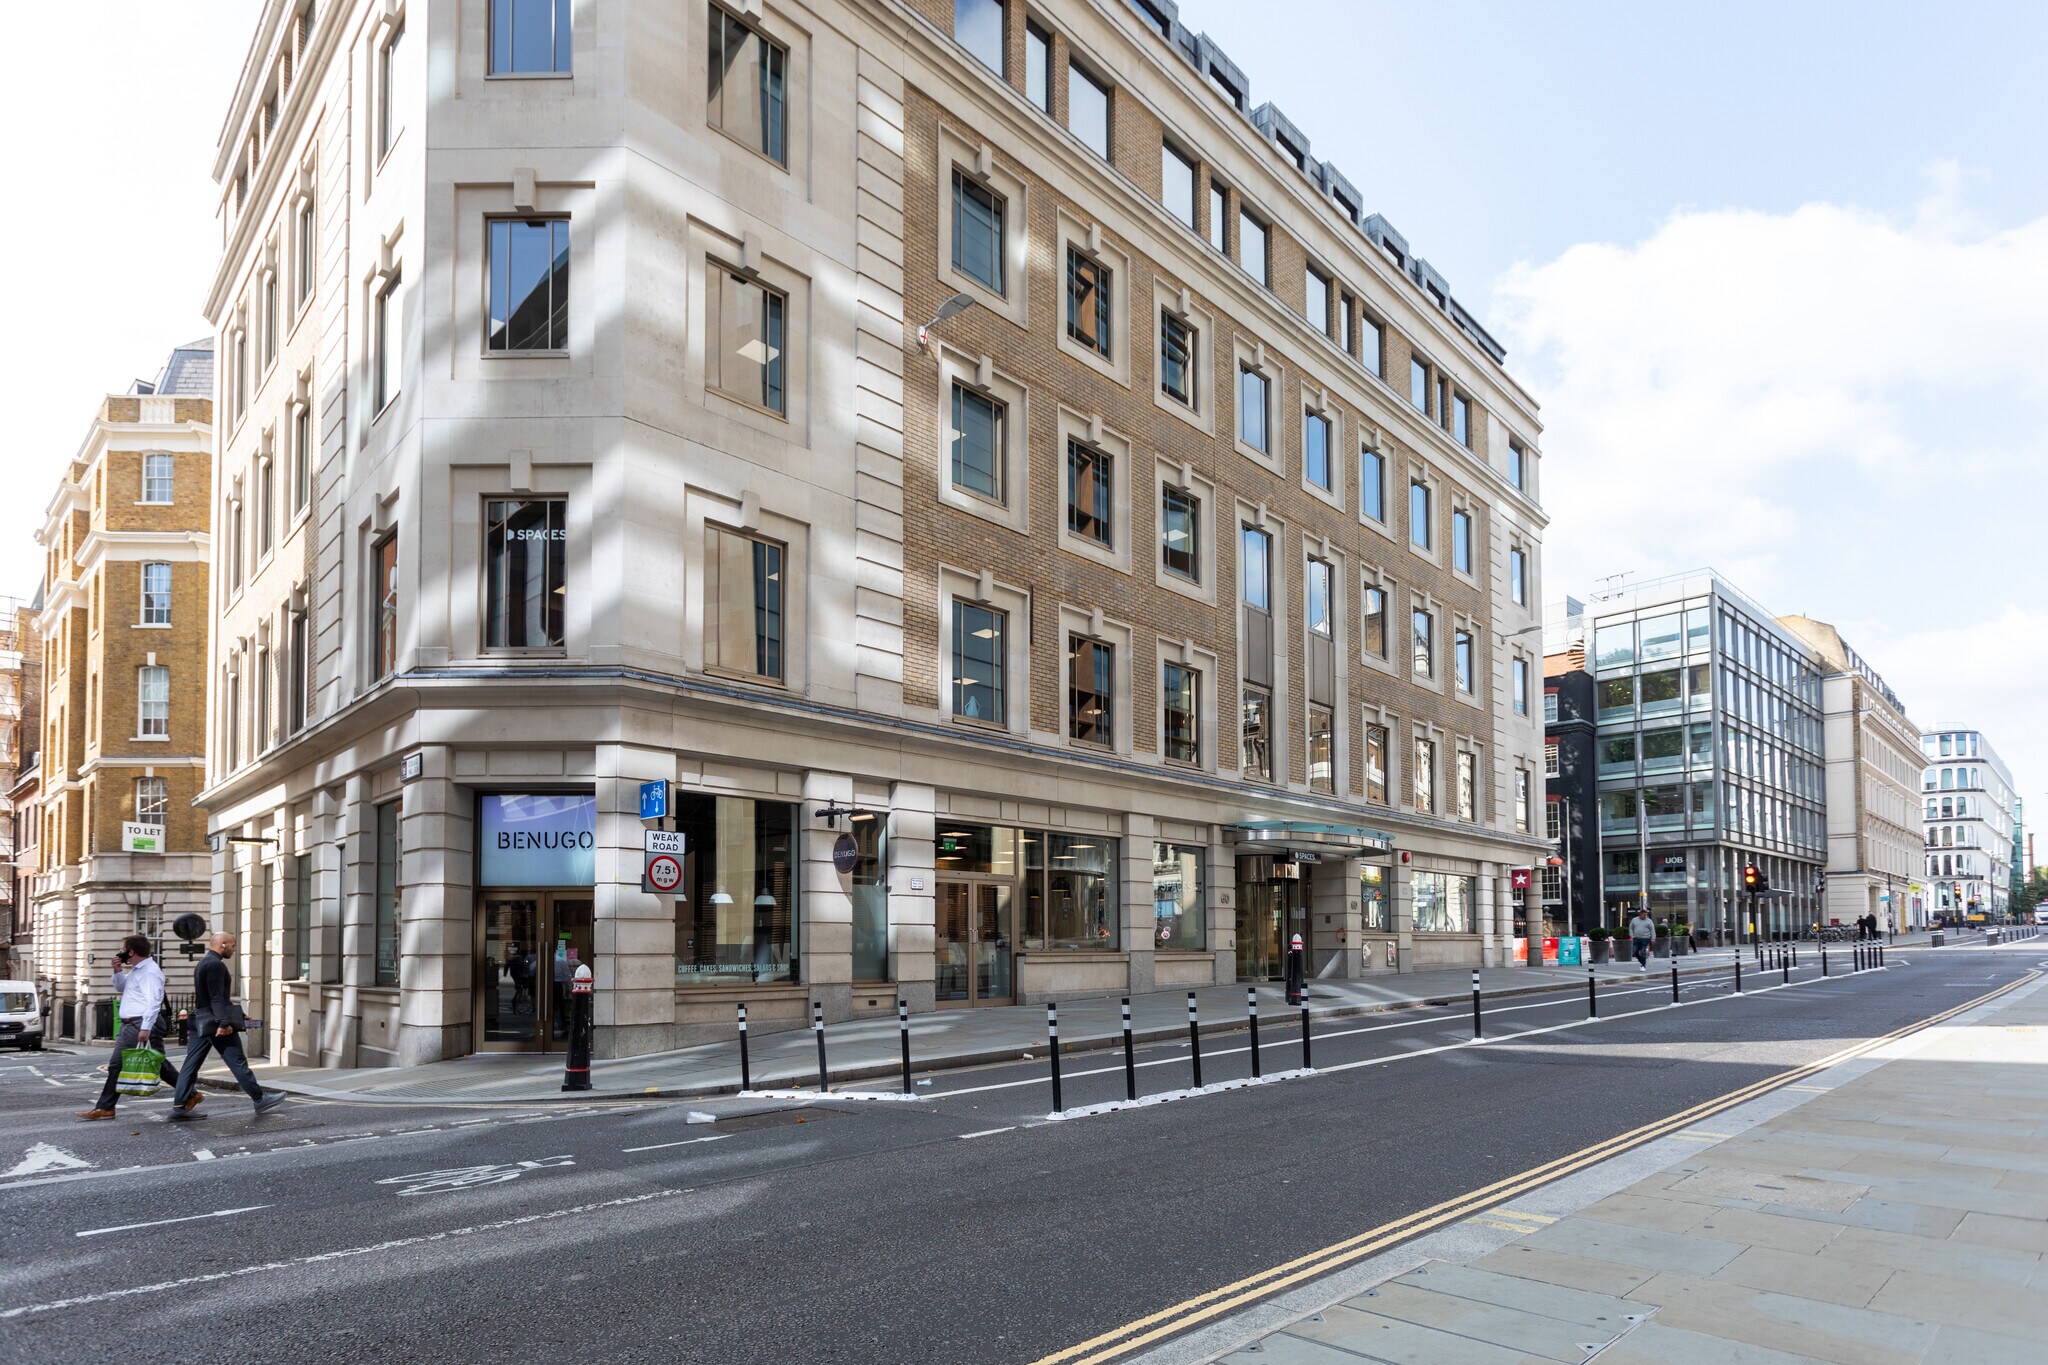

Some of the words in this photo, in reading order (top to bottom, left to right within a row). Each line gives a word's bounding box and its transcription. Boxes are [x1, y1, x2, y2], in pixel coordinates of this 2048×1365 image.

[128, 826, 141, 834] TO
[498, 831, 594, 849] BENUGO
[652, 833, 679, 843] WEAK
[652, 842, 679, 852] ROAD
[834, 849, 856, 859] BENUGO
